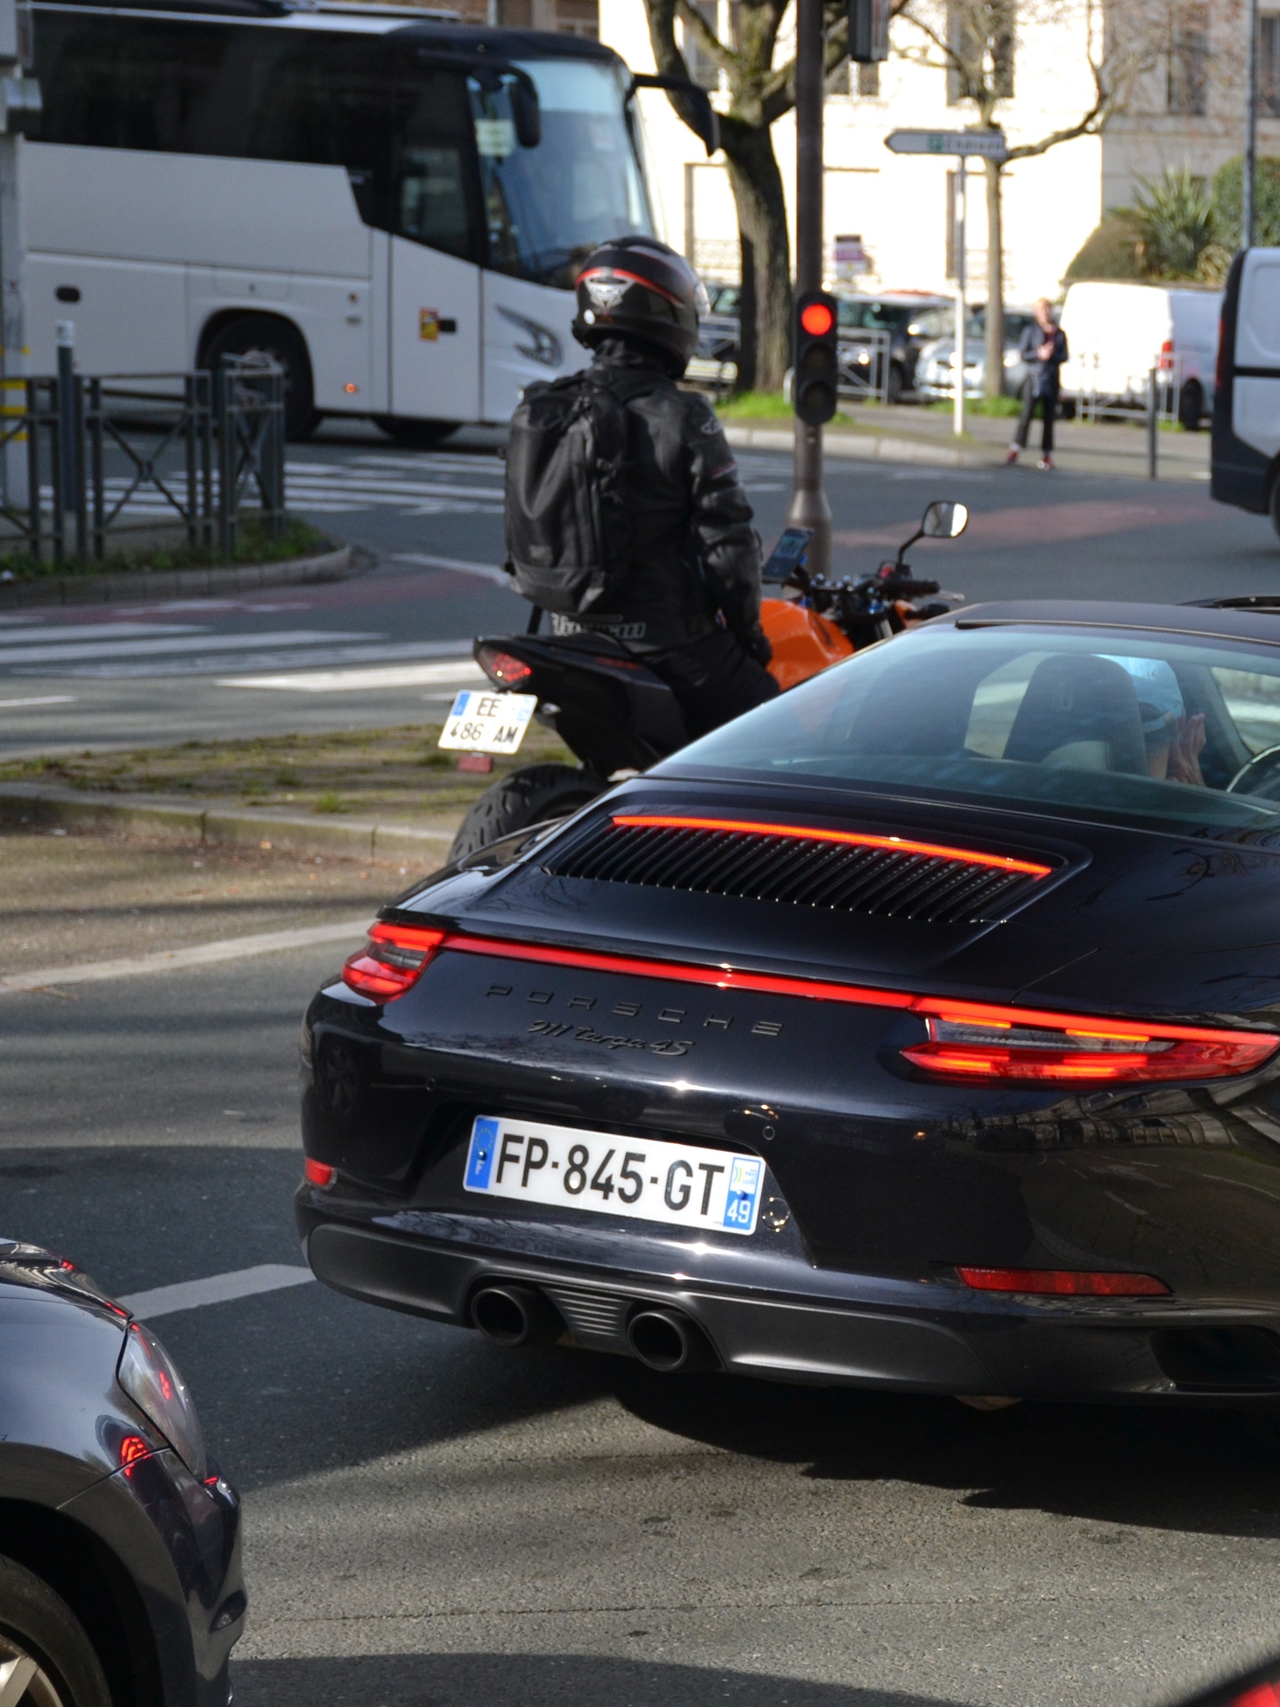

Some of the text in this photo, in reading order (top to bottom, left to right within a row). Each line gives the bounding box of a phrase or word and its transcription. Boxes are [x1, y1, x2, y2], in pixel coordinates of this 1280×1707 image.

[476, 697, 502, 717] EE
[450, 722, 519, 744] 486 AM
[485, 985, 783, 1036] PORSCHE
[527, 1019, 574, 1037] 911
[650, 1039, 695, 1056] 4S
[496, 1133, 725, 1216] FP-845-GT
[727, 1199, 751, 1224] 49
